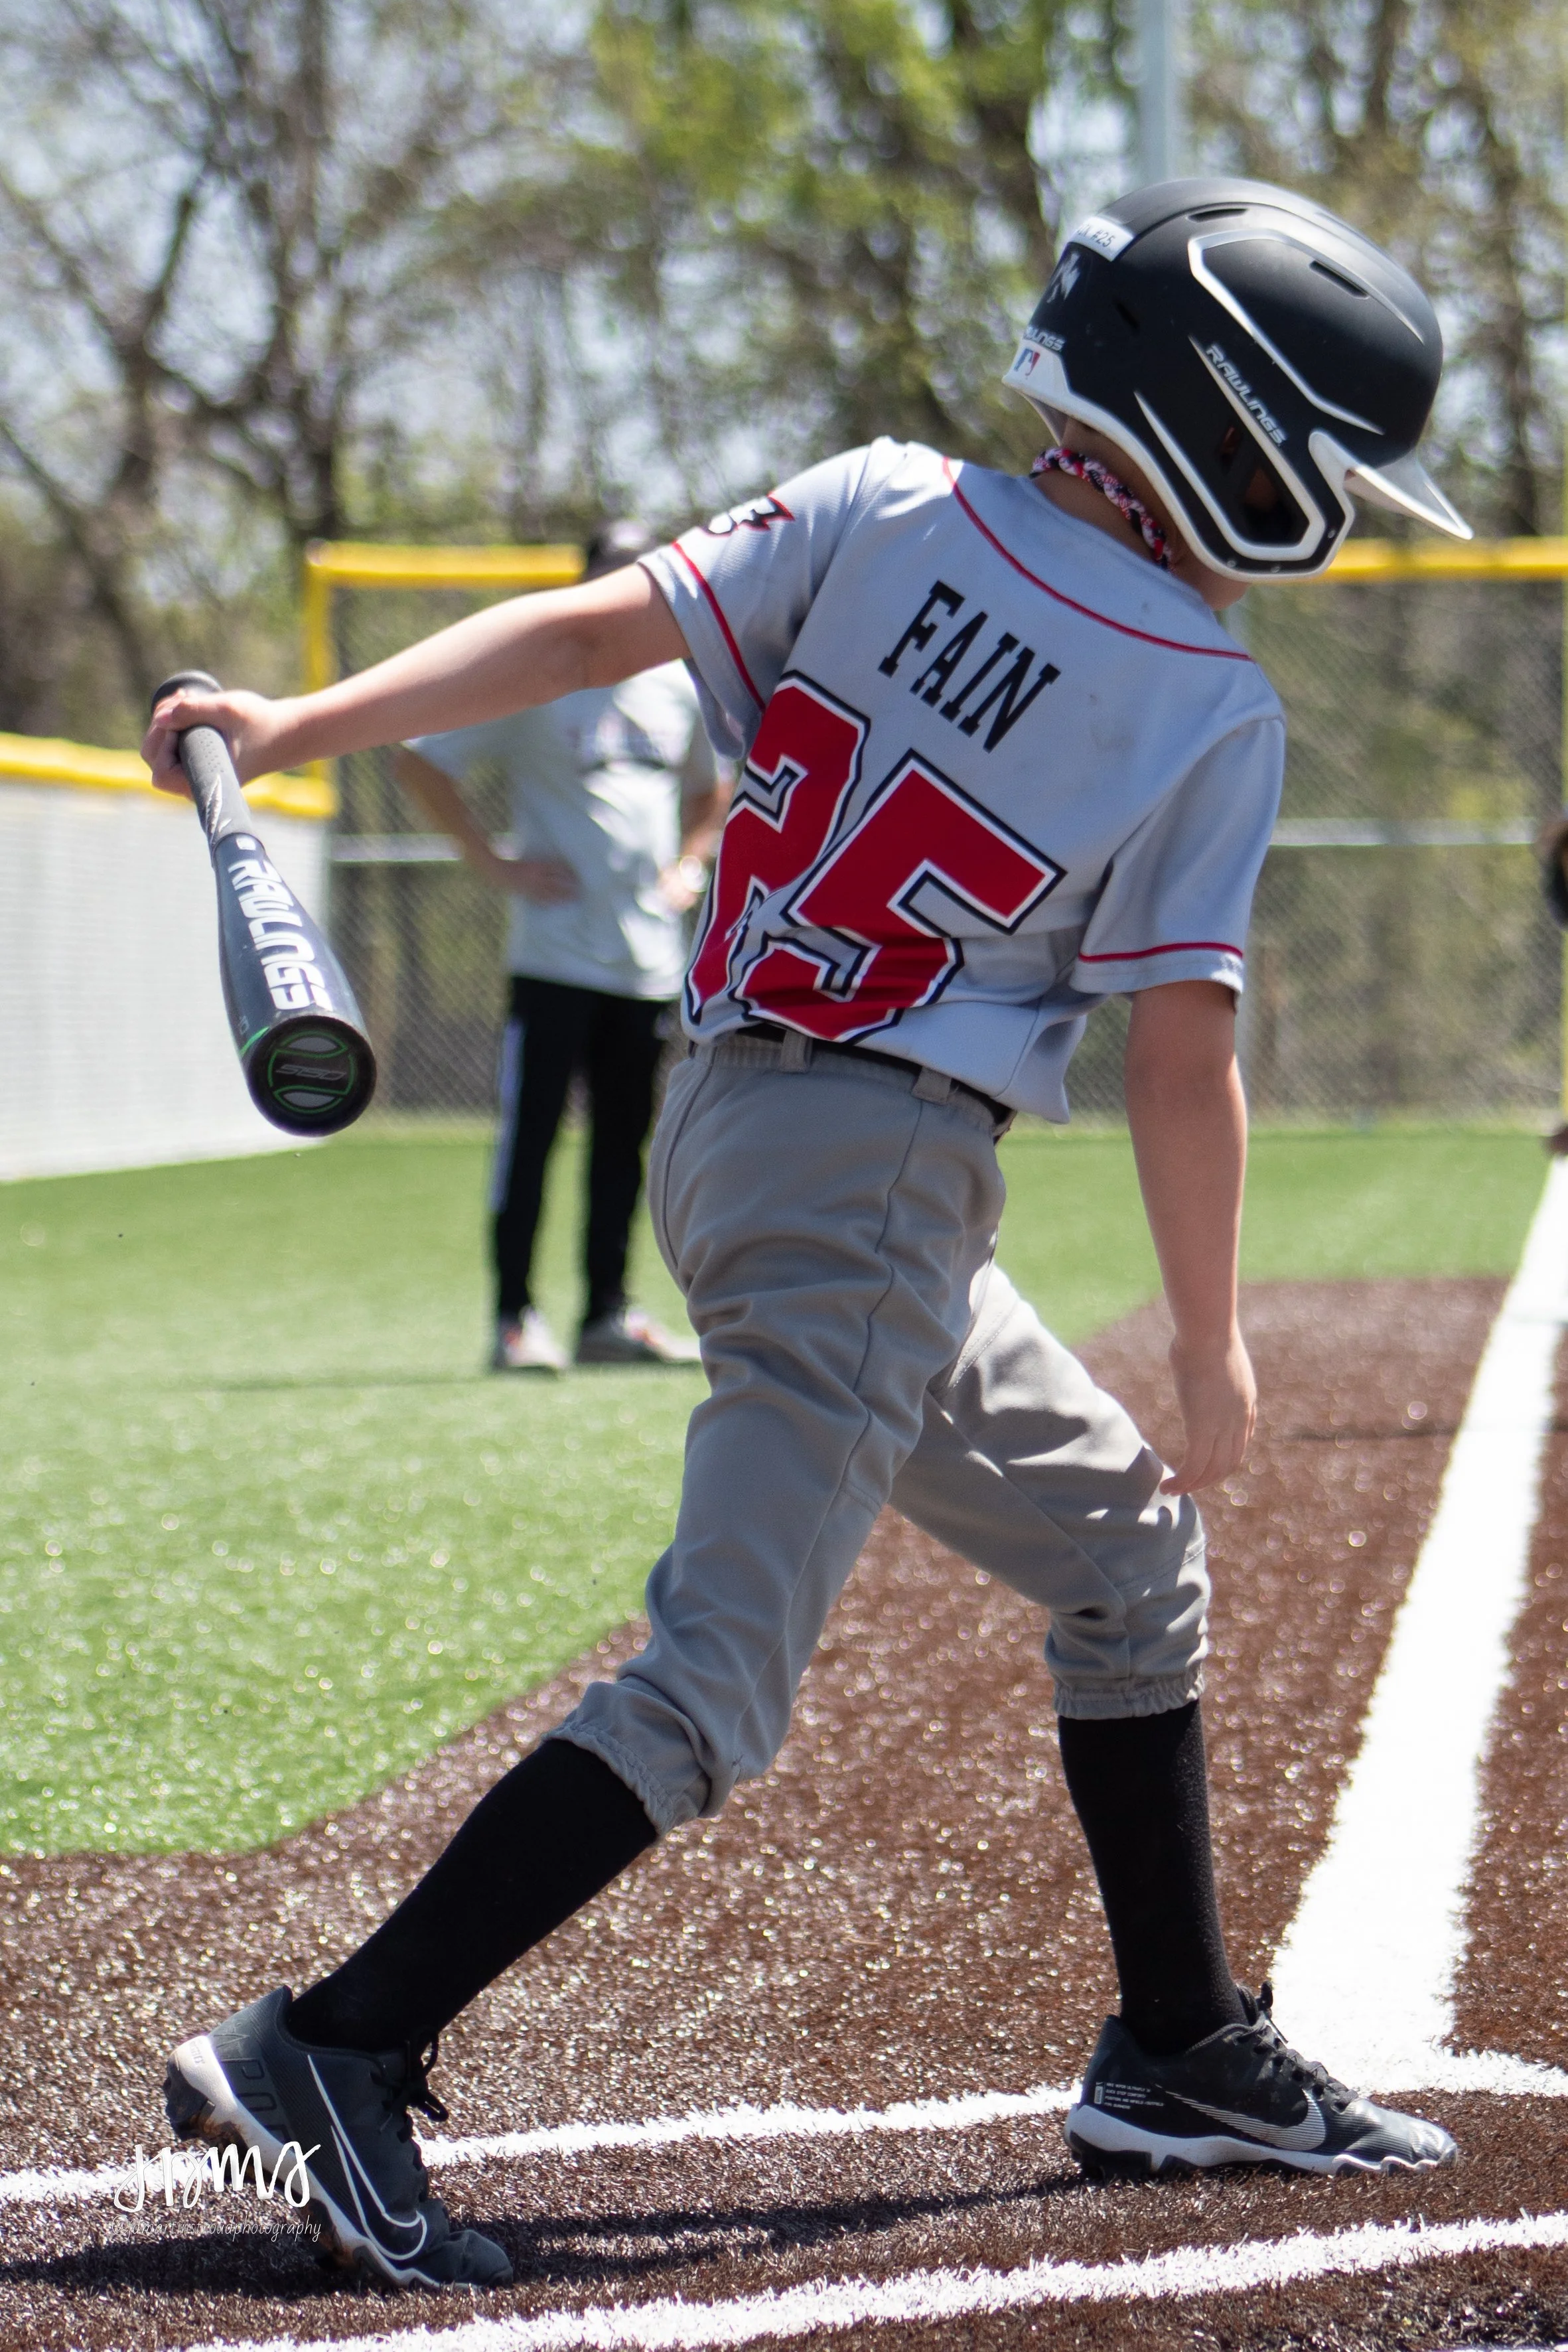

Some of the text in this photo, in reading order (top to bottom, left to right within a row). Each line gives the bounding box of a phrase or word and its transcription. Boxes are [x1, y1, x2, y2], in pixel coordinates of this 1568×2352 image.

[1206, 344, 1287, 445] RAWLINGS
[877, 580, 1060, 753] FAIN
[228, 858, 333, 1011] RAWLINGS
[683, 668, 1068, 1045] 25
